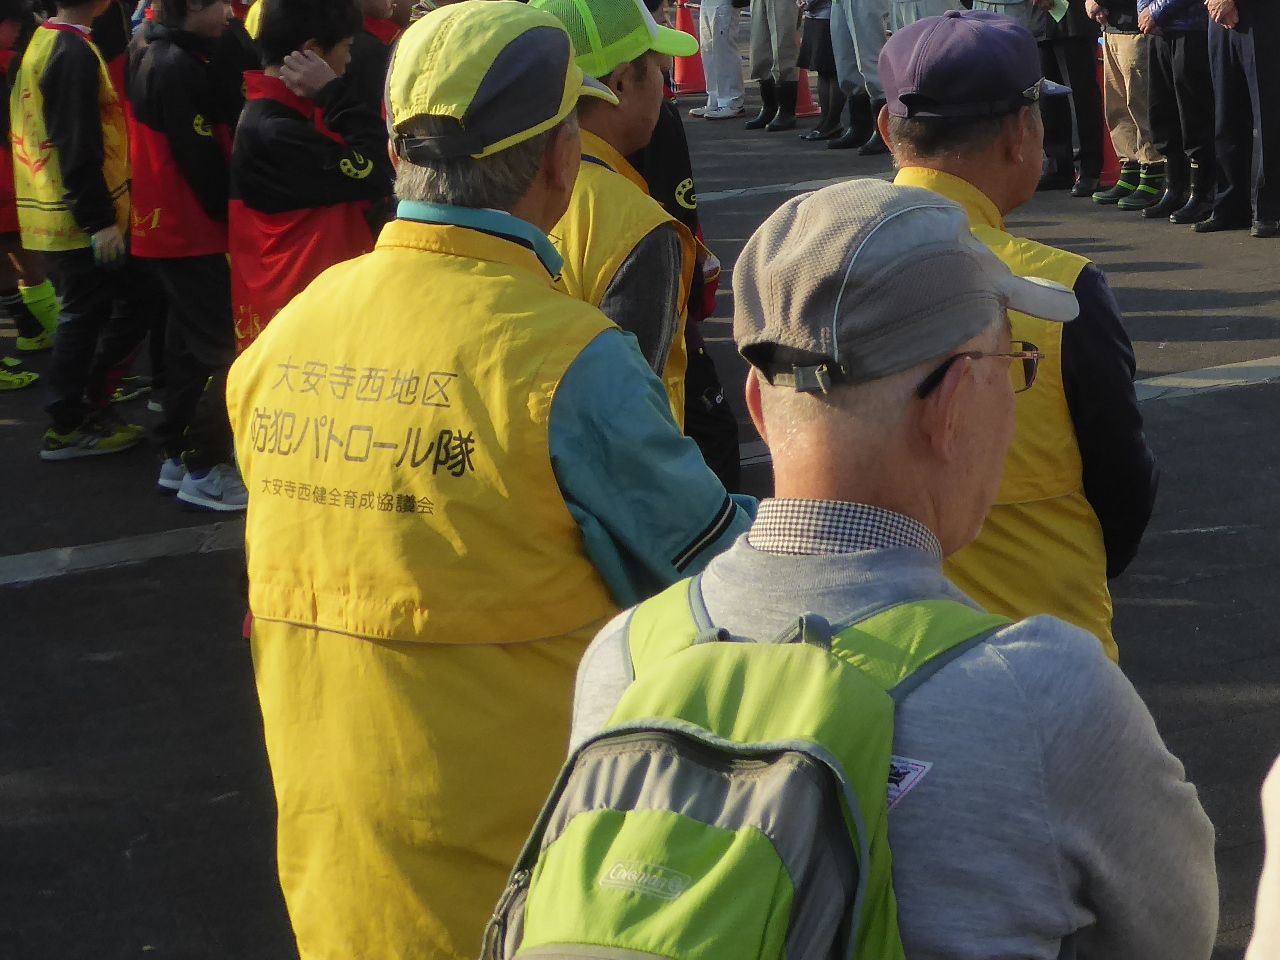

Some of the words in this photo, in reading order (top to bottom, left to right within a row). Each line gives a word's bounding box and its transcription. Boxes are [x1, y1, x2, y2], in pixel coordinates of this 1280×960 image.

[272, 356, 458, 408] 大安寺西地区
[250, 406, 476, 478] 防犯パトロール隊
[261, 476, 434, 516] 大安寺西健全育成協議会
